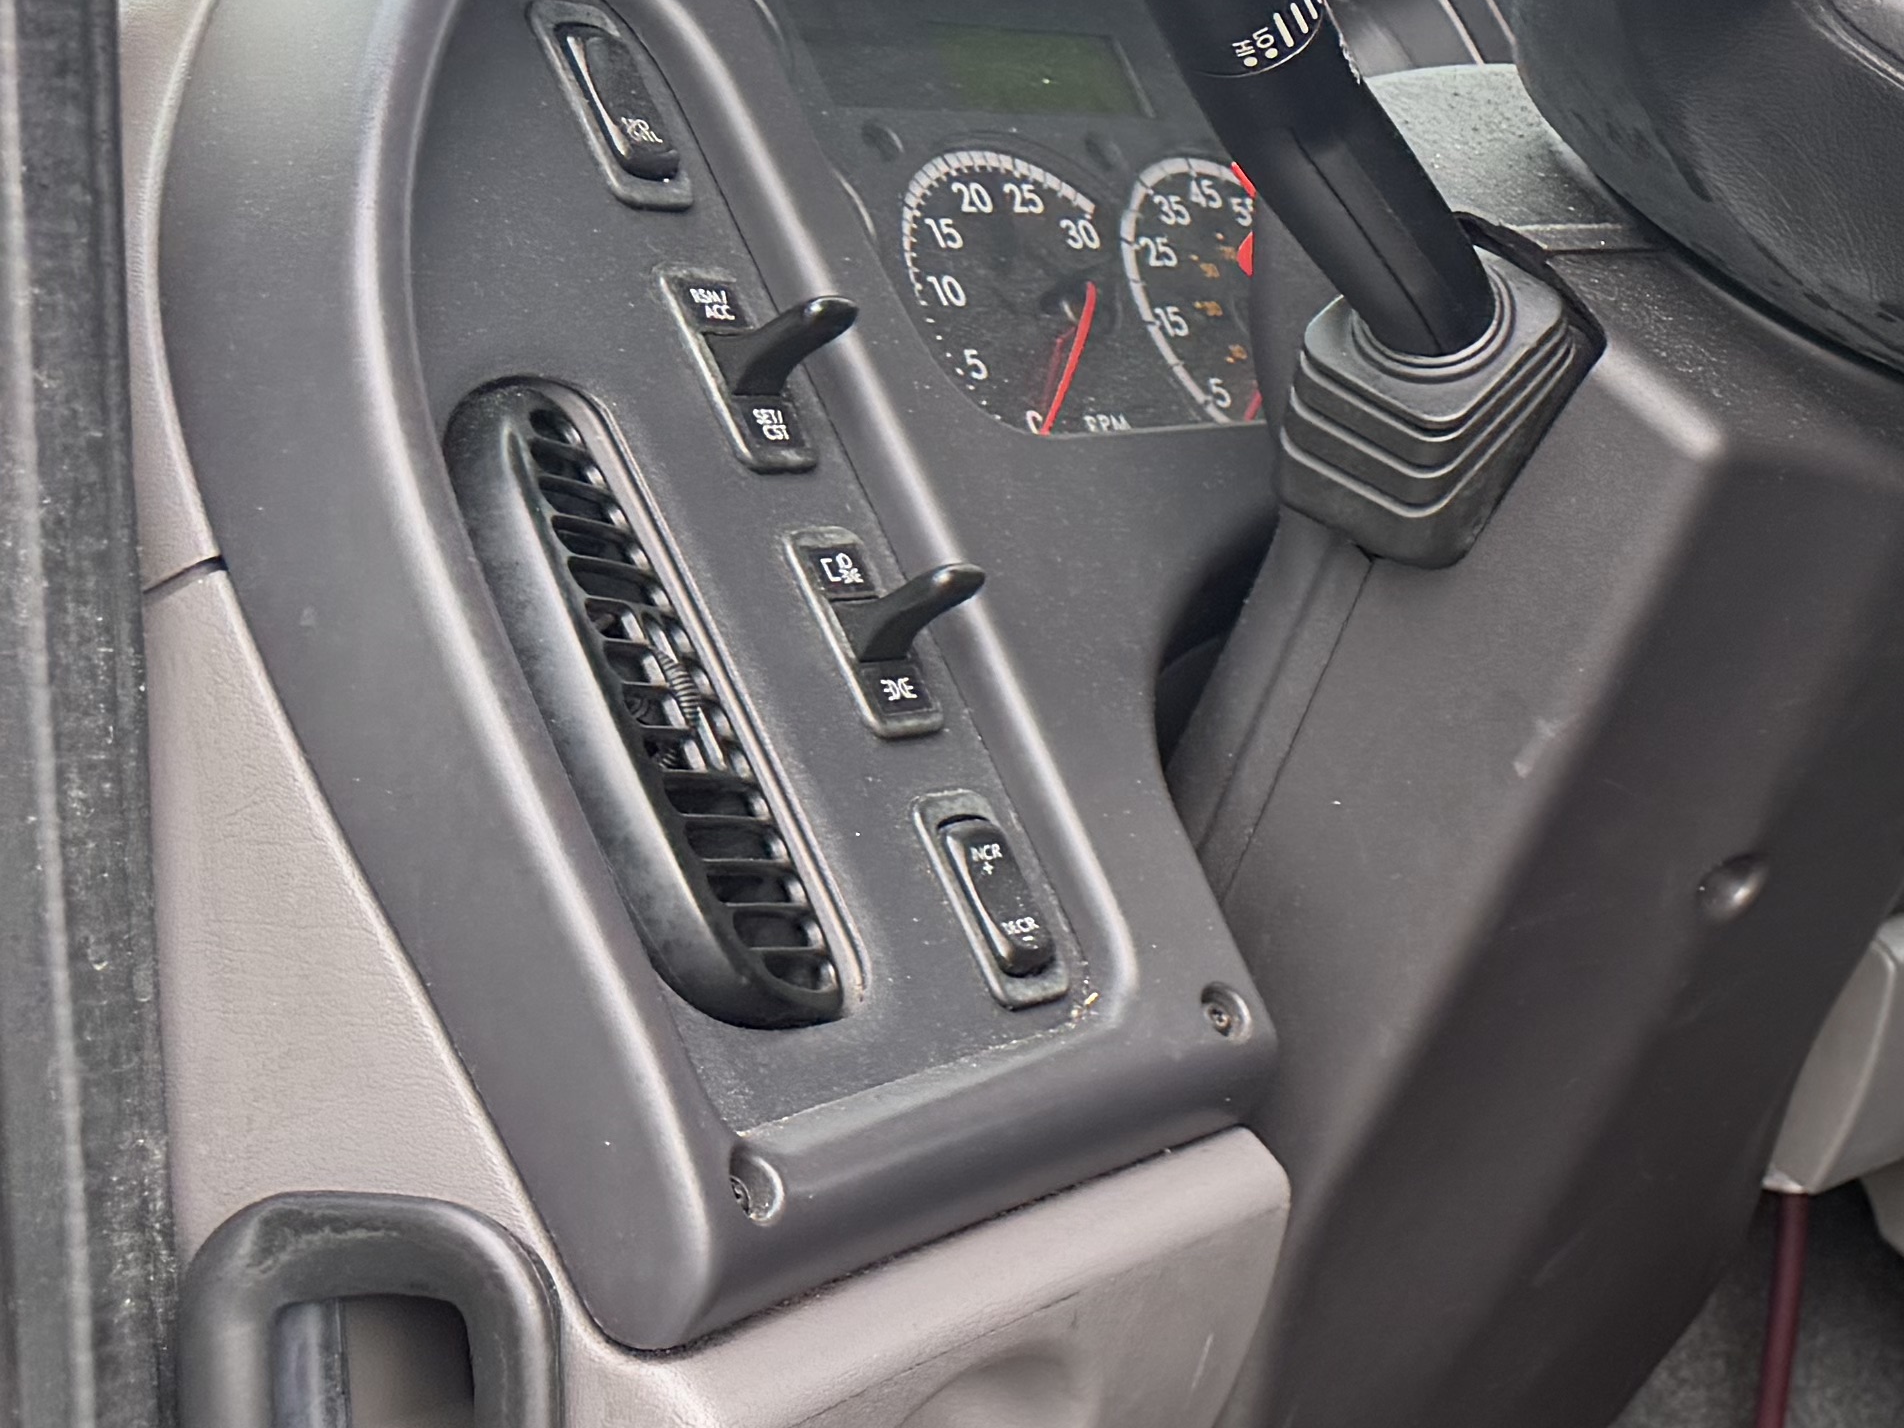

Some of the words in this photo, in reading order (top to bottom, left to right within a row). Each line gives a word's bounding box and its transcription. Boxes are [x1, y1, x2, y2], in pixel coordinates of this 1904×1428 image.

[1232, 40, 1256, 57] HI
[1252, 27, 1275, 49] LO
[952, 182, 993, 214] 20
[1003, 183, 1045, 214] 25
[1189, 180, 1222, 209] 45
[1153, 195, 1191, 226] 35
[924, 218, 964, 249] 15
[1059, 220, 1100, 249] 30
[1139, 236, 1178, 267] 25
[926, 275, 967, 307] 10
[705, 305, 736, 321] ACC
[1154, 306, 1190, 337] 15
[963, 349, 989, 380] 5
[1208, 377, 1232, 408] 5
[752, 408, 784, 425] SET/
[762, 424, 790, 441] CST
[969, 843, 1003, 862] INCR
